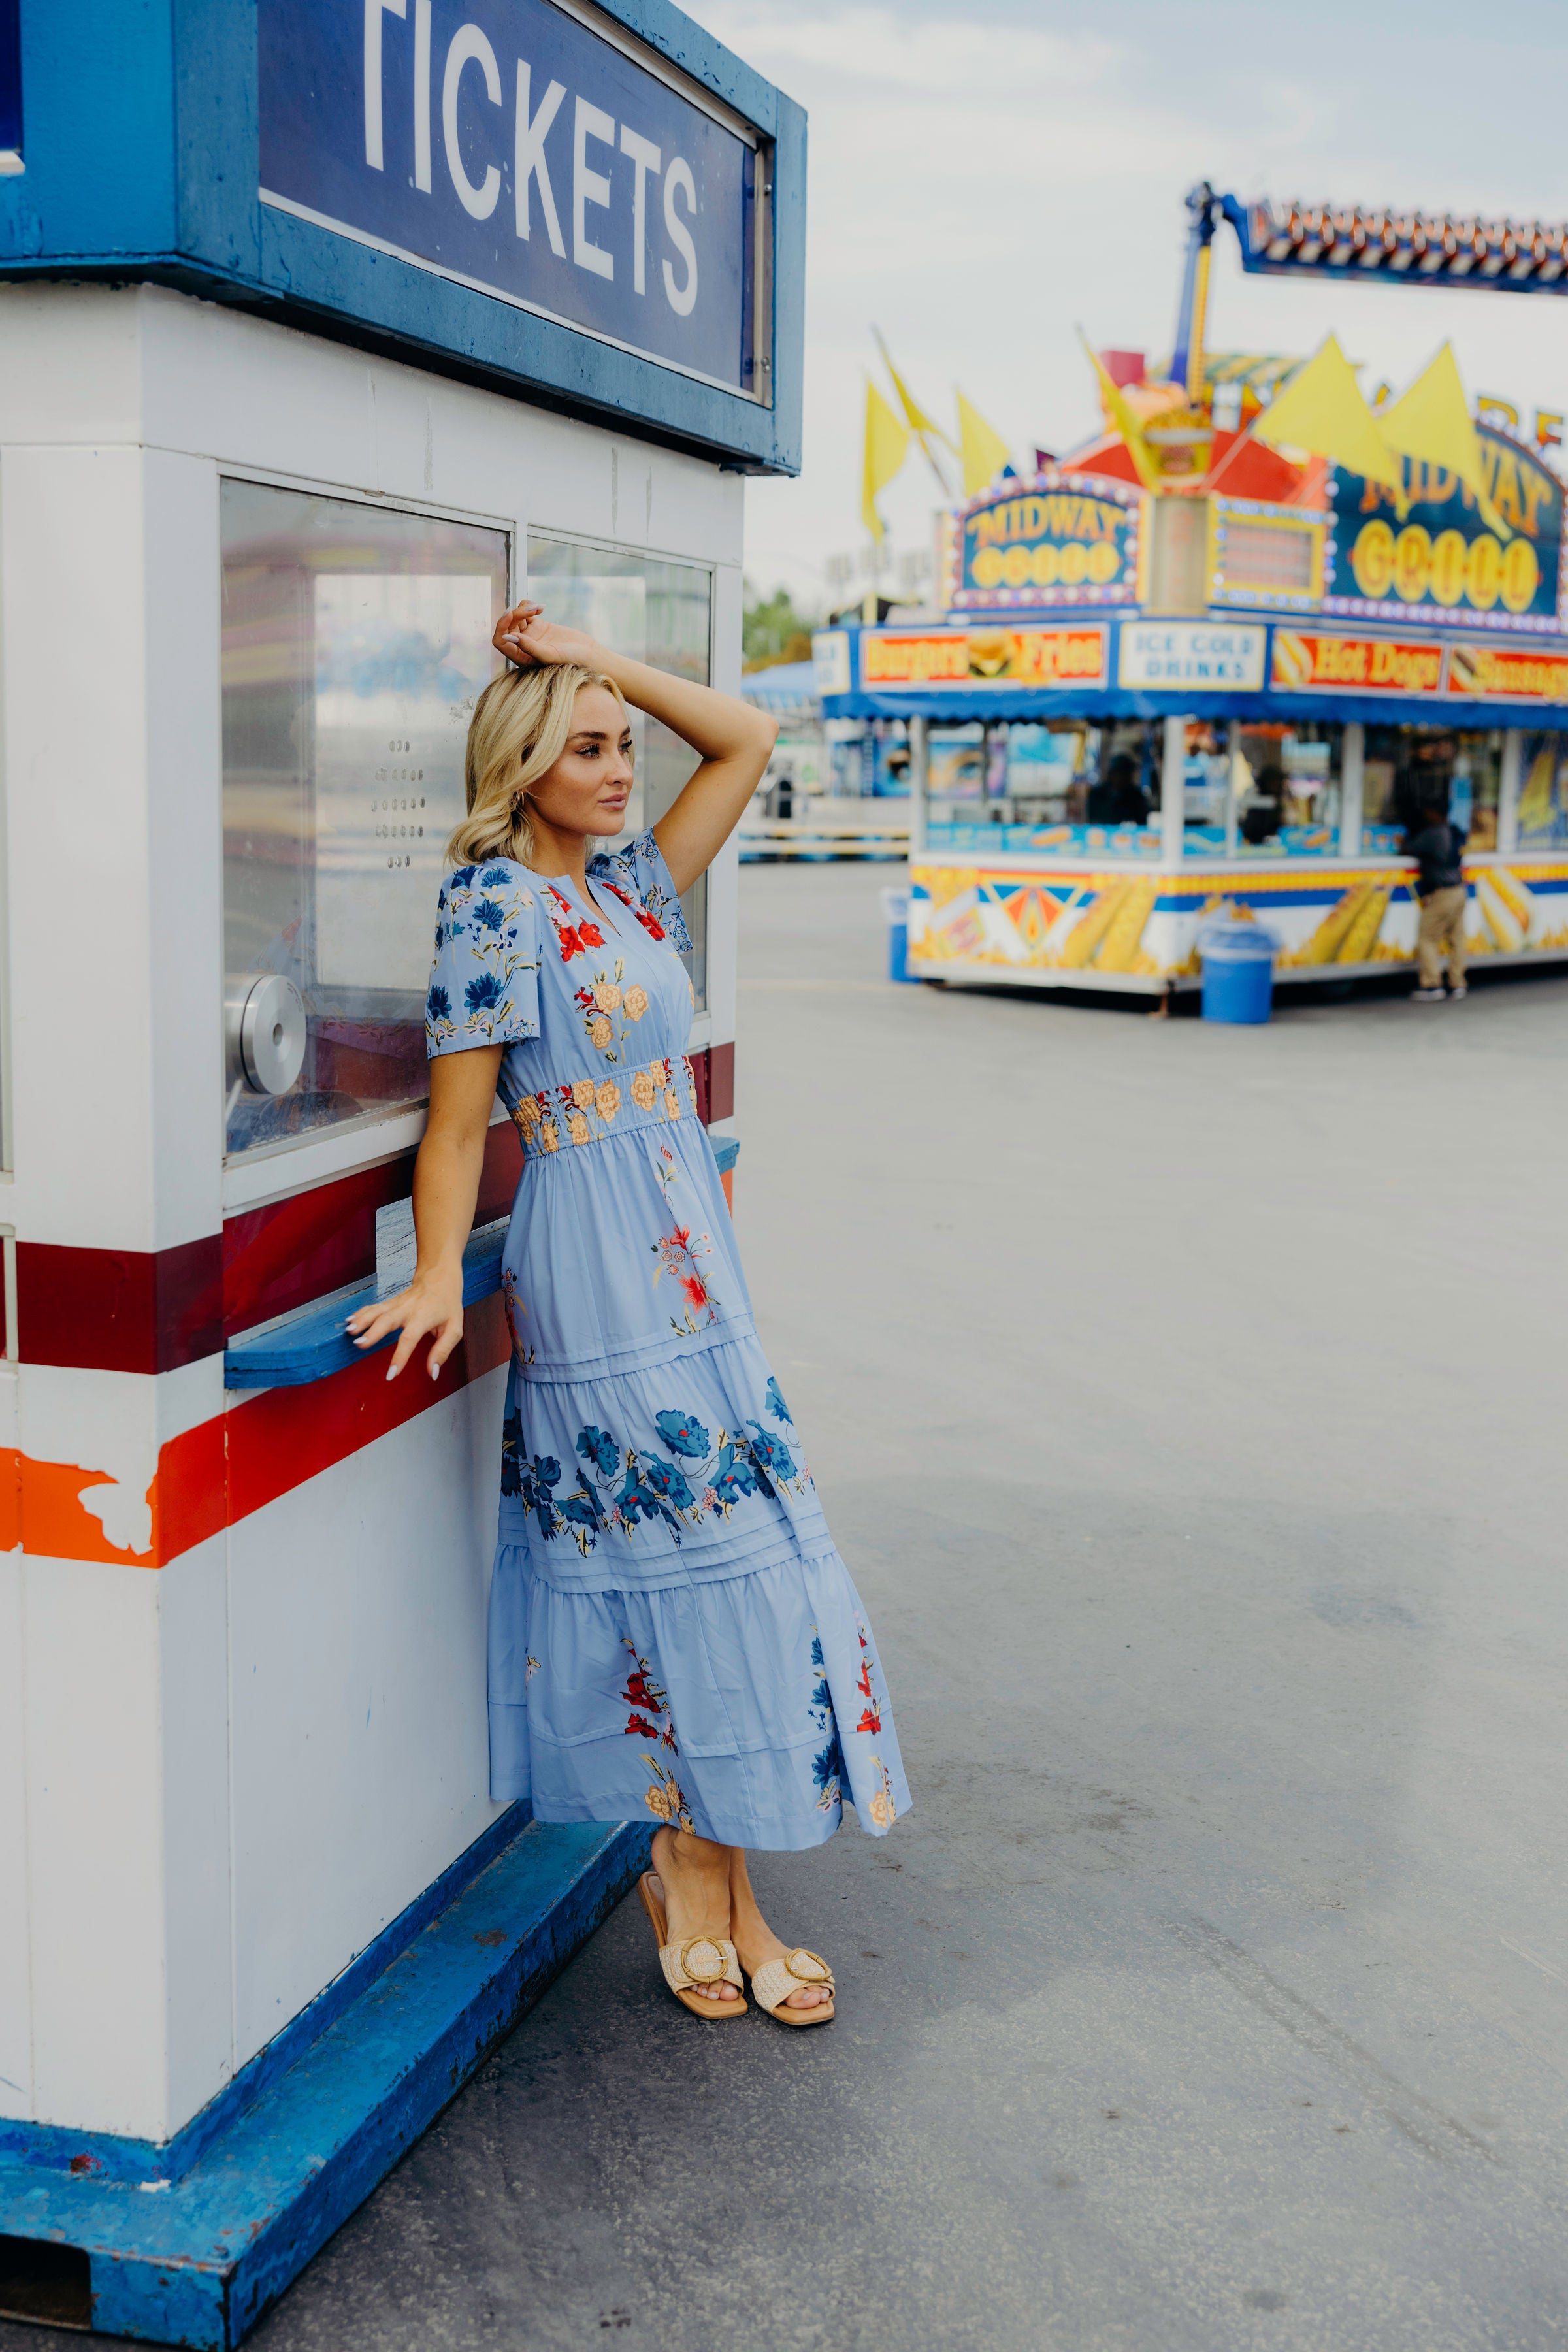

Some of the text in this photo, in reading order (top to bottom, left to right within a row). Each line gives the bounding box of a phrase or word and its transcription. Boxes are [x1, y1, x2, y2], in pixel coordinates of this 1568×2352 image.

[363, 0, 698, 318] TICKETS
[966, 494, 1127, 549] MIDWAY
[1361, 527, 1529, 603] GRILL
[1021, 632, 1100, 677] Fries
[1135, 632, 1254, 655] ICE COLD
[1146, 659, 1245, 679] DRINKS
[1316, 638, 1436, 694] Hot Dogs
